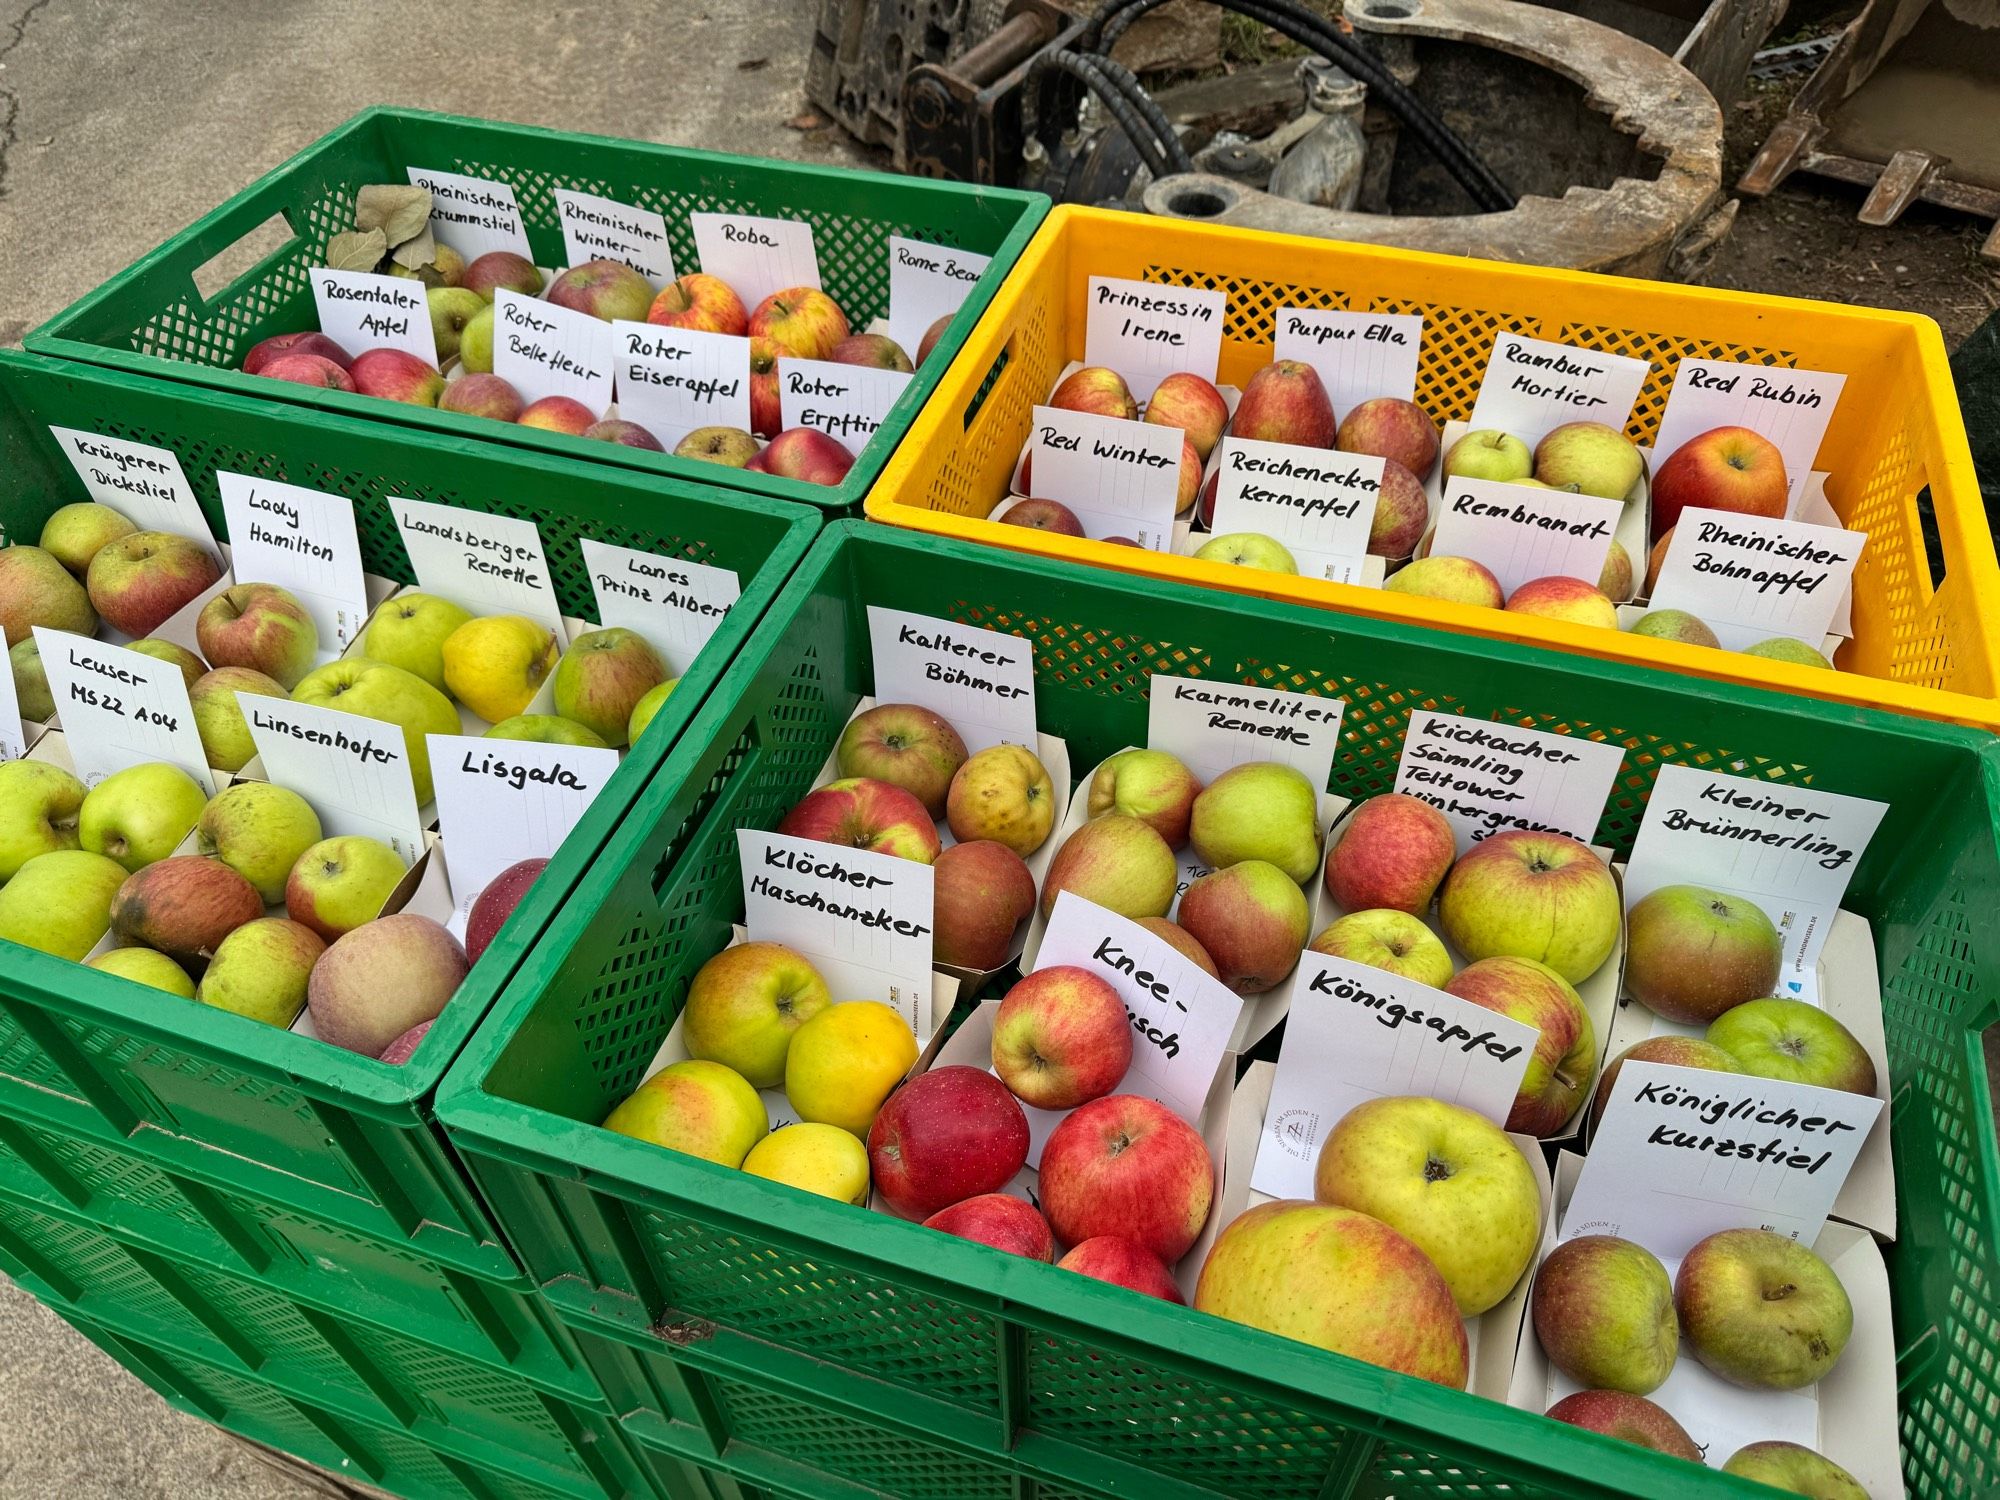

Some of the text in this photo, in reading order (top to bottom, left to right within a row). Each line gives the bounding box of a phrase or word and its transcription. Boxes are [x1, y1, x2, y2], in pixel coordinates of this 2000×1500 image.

[562, 201, 663, 242] Rheinischer
[575, 229, 641, 253] Winter-
[721, 224, 779, 247] Roba
[898, 247, 940, 273] Rome
[322, 280, 420, 309] Rosentaler
[1097, 286, 1212, 322] Prinzessin
[359, 314, 408, 337] Apfel
[503, 303, 557, 332] Roter
[1121, 318, 1185, 346] Irene
[1287, 317, 1408, 346] Purpur Ella
[508, 334, 601, 380] Bellefleur
[626, 333, 692, 360] Roter
[1505, 342, 1604, 378] Rambur
[629, 364, 739, 403] Eiserapfel
[787, 372, 849, 397] Roter
[1512, 375, 1608, 408] Mortier
[1687, 367, 1822, 409] Red Rubin
[800, 408, 880, 436] Erpftin
[74, 437, 171, 474] Krügerer
[1040, 426, 1176, 470] Red Winter
[90, 467, 177, 503] Dickstiel
[1230, 451, 1382, 493] Reichenecker
[248, 489, 299, 529] Lady
[1239, 484, 1360, 520] Kernapfel
[1452, 494, 1611, 541] Rembrandt
[250, 522, 334, 562] Hamilton
[403, 513, 538, 563] Landsberger
[1697, 522, 1849, 567] Rheinischer
[463, 553, 543, 590] Renette
[628, 558, 690, 587] Lanes
[1692, 552, 1828, 596] Bohnapfel
[597, 574, 732, 617] Prinz Albert
[898, 624, 1016, 666] Kalterer
[69, 648, 148, 686] Leuser
[925, 662, 1030, 700] Böhmer
[1174, 684, 1338, 724] Karmeliter
[253, 710, 398, 764] Linsenhofer
[1207, 711, 1311, 747] Renette
[1422, 718, 1581, 765] Kickacher
[462, 750, 587, 791] Lisgala
[1404, 765, 1525, 802] Teltower
[1408, 743, 1524, 786] Sämling
[1699, 782, 1832, 823] Kleiner
[1661, 808, 1853, 870] Brünnerling
[764, 845, 894, 889] Klöcher
[750, 875, 931, 937] Maschanzker
[1092, 936, 1188, 1013] Knee-
[1308, 968, 1523, 1063] Königsapfel
[1634, 1080, 1857, 1135] Königlicher
[1646, 1122, 1832, 1176] Kurzstiel
